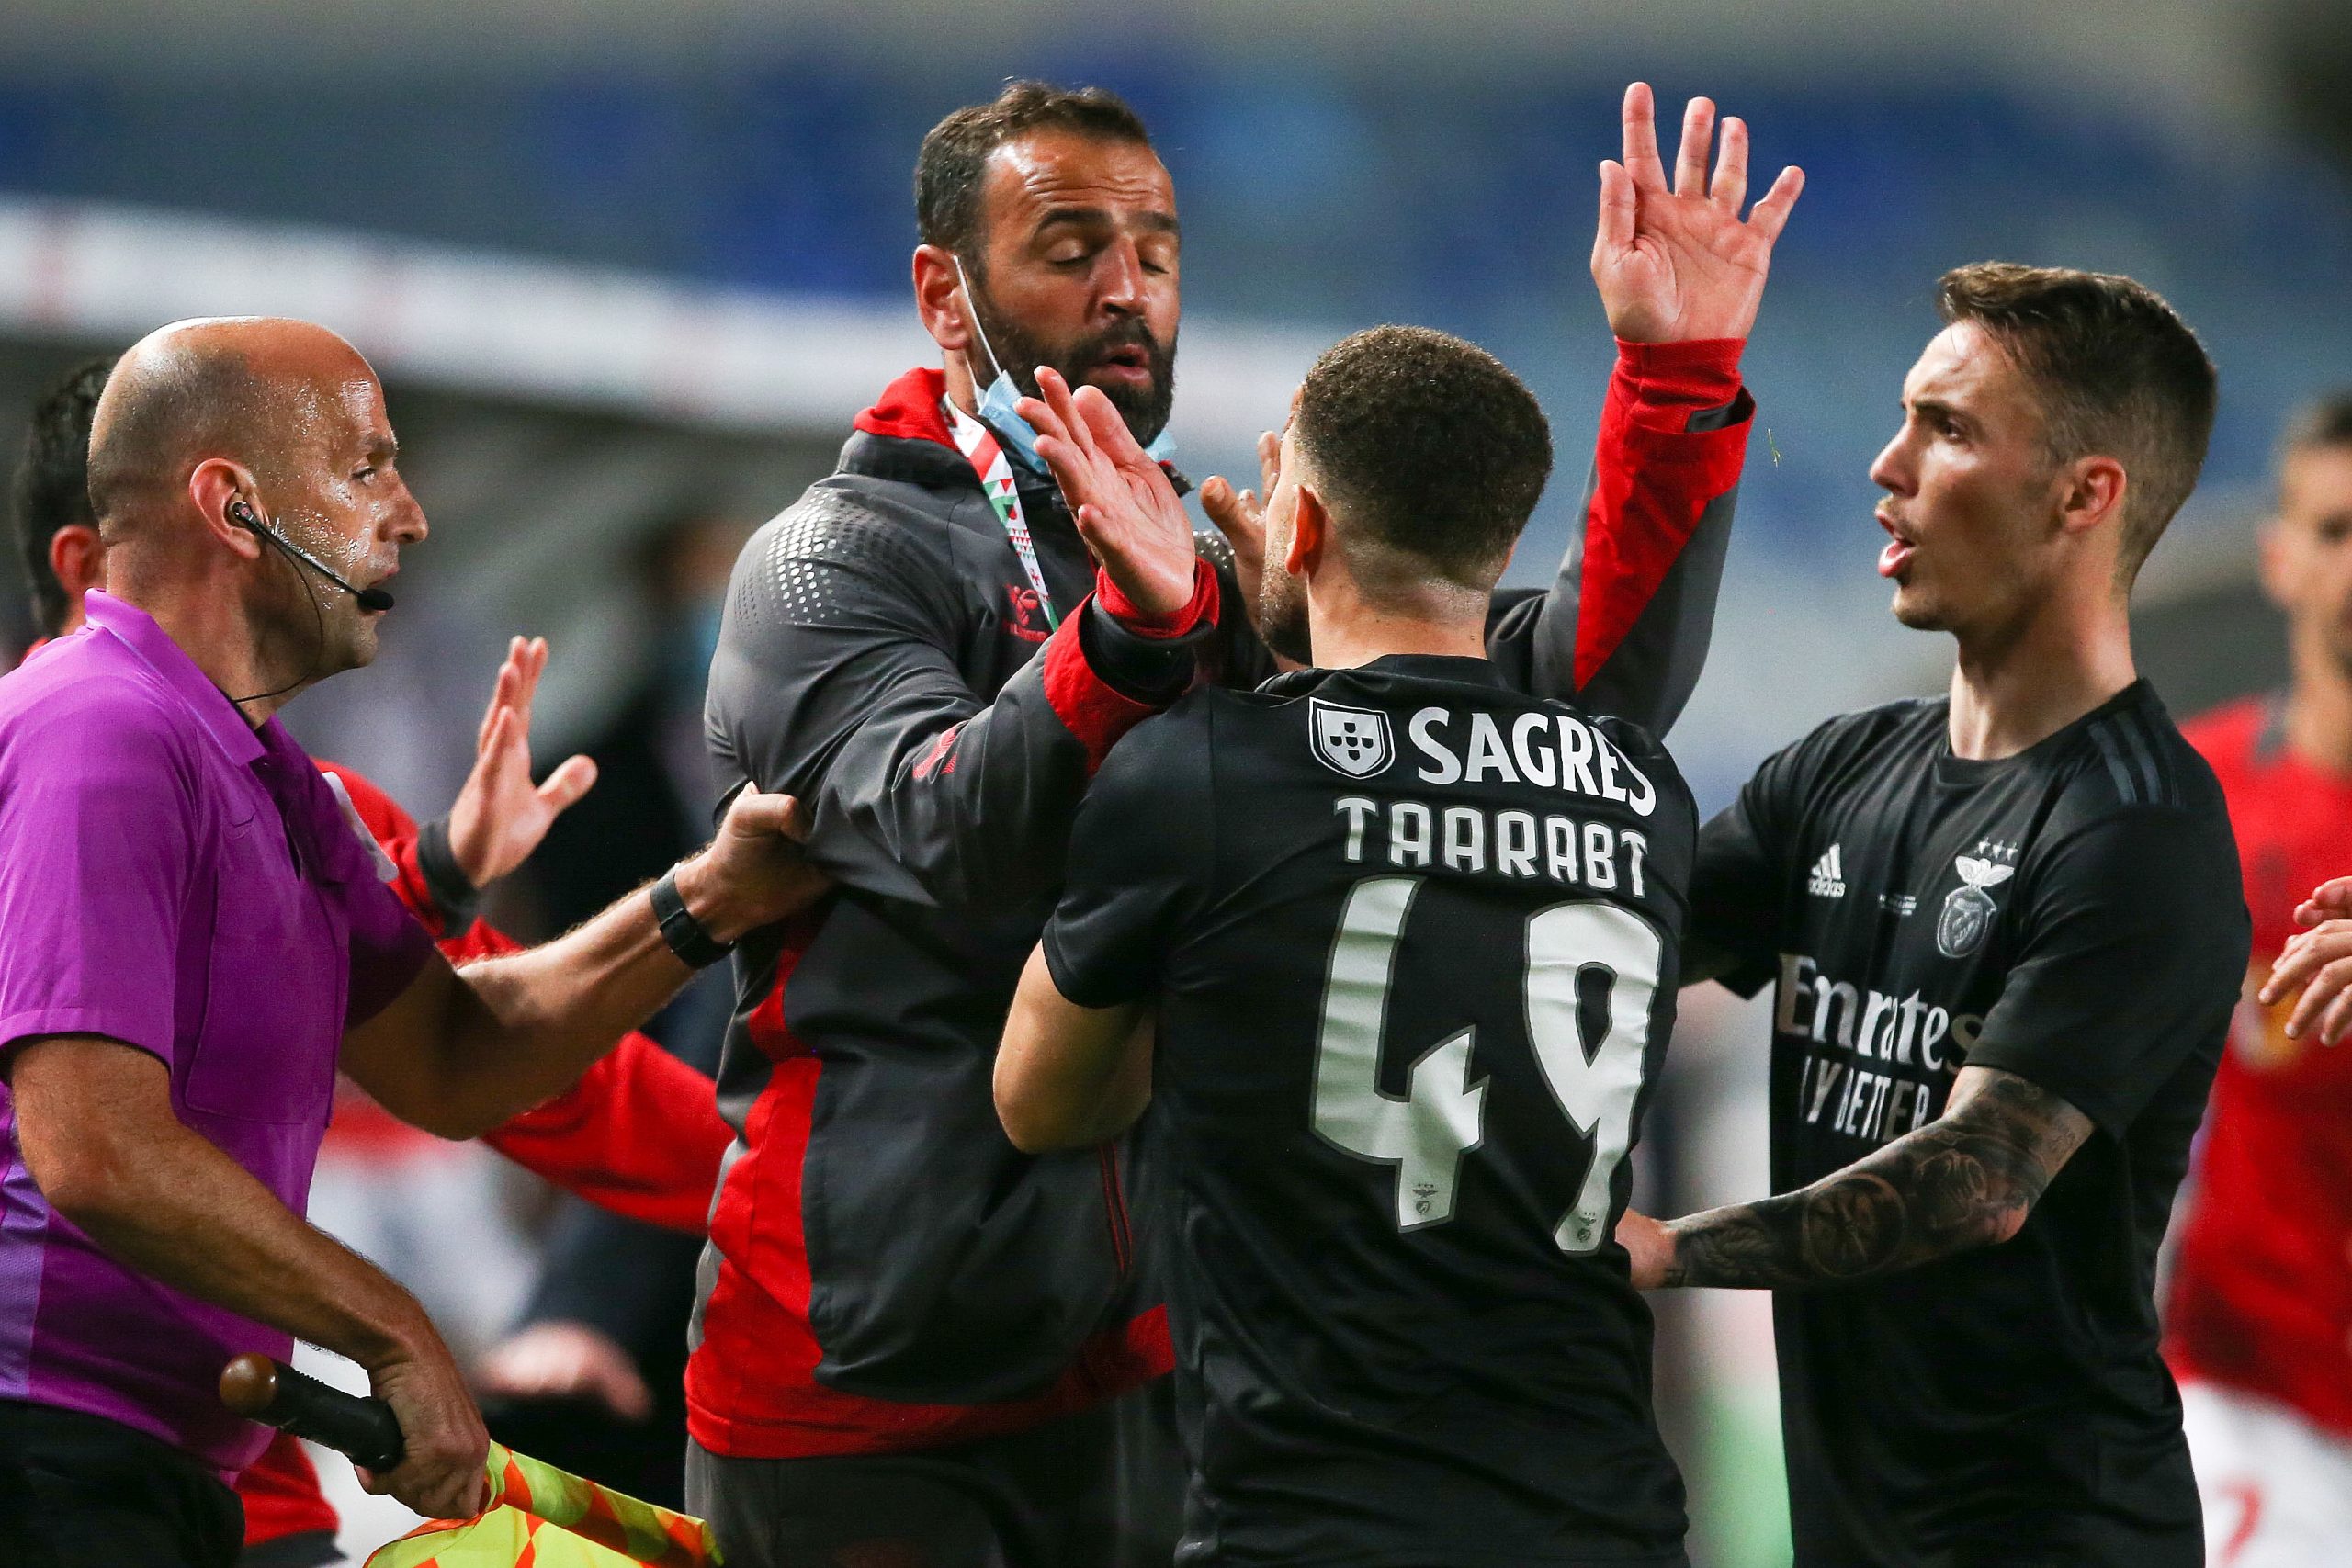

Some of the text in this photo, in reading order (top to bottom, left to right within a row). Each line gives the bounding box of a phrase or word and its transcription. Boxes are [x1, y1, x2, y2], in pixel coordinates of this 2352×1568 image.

[1408, 706, 1657, 817] SAGRES
[1333, 795, 1649, 899] TAARABT
[1309, 874, 1664, 1257] 49
